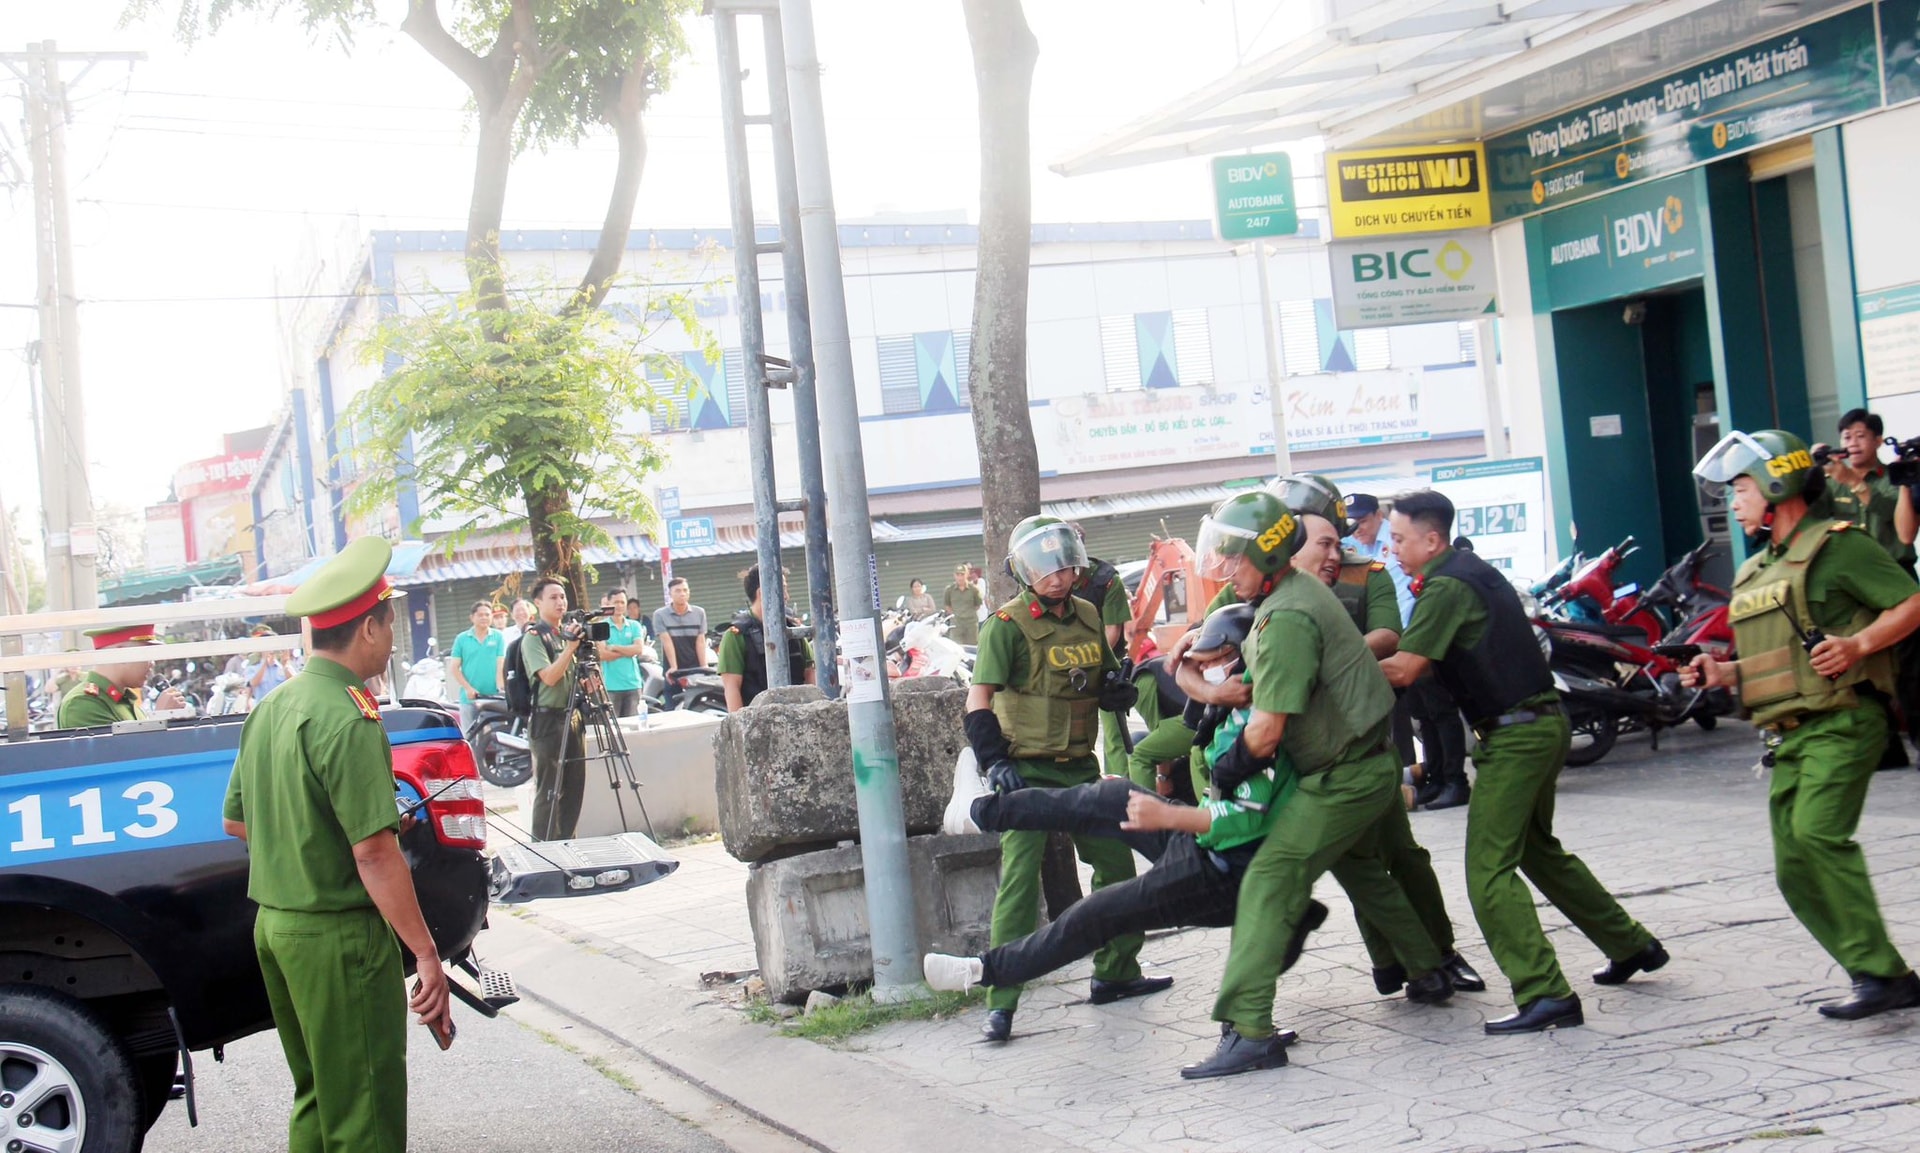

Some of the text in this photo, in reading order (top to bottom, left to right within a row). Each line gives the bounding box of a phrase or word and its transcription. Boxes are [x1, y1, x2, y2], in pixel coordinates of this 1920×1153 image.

[1527, 130, 1560, 158] Vững
[1558, 117, 1590, 148] bước
[1588, 106, 1617, 138] Tiên
[1664, 79, 1700, 111] Đồng
[1699, 64, 1736, 100] hành
[1735, 52, 1771, 88] Phát
[1771, 36, 1809, 77] triển
[1228, 166, 1264, 183] BIDV
[1342, 161, 1418, 181] WESTERN
[1367, 175, 1420, 194] UNION
[1425, 157, 1471, 188] WU
[1544, 170, 1585, 197] 1900 9247
[1228, 194, 1285, 209] AUTOBANK
[1246, 216, 1270, 228] 24/7
[1614, 207, 1665, 258] BIDV
[1551, 234, 1601, 266] AUTOBANK
[1351, 248, 1432, 283] BIC
[1405, 288, 1415, 296] TY
[1457, 284, 1476, 293] BIDV
[1200, 392, 1237, 407] SHOP
[1287, 384, 1402, 419] Kim Loan
[1371, 420, 1398, 431] TRANG
[1400, 418, 1418, 428] NAM
[1764, 449, 1814, 478] CS113
[1459, 503, 1526, 537] 5.2%
[1048, 641, 1102, 668] CS113
[8, 780, 179, 852] 113
